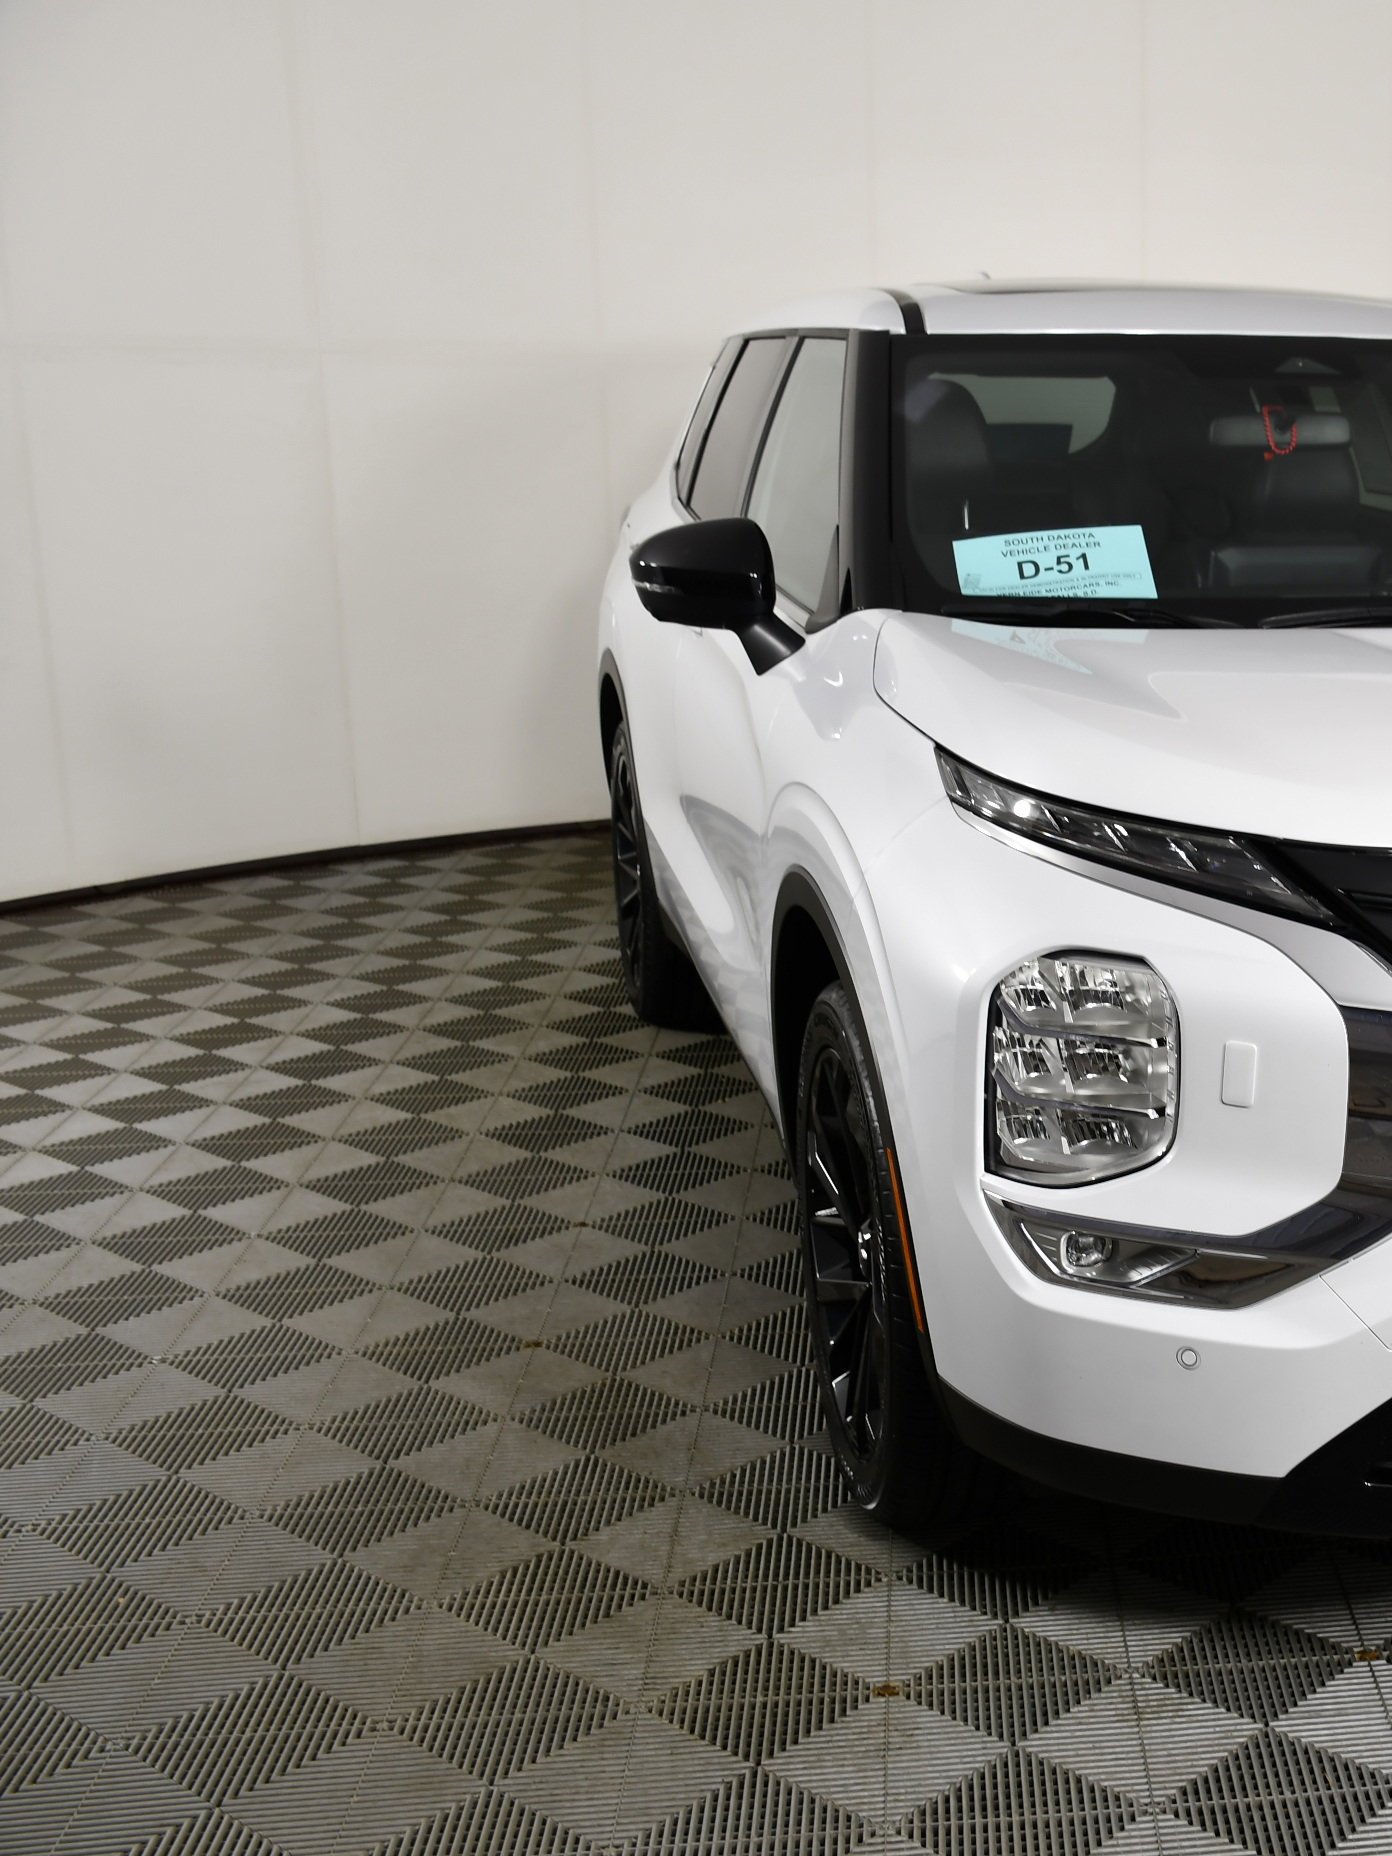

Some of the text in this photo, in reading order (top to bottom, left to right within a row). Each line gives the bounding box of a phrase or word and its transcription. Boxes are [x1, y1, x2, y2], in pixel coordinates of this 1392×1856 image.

[1004, 532, 1095, 547] SOUTH DAKOTA
[1001, 541, 1101, 558] VEHICLE DEALER
[1017, 552, 1090, 580] D-51
